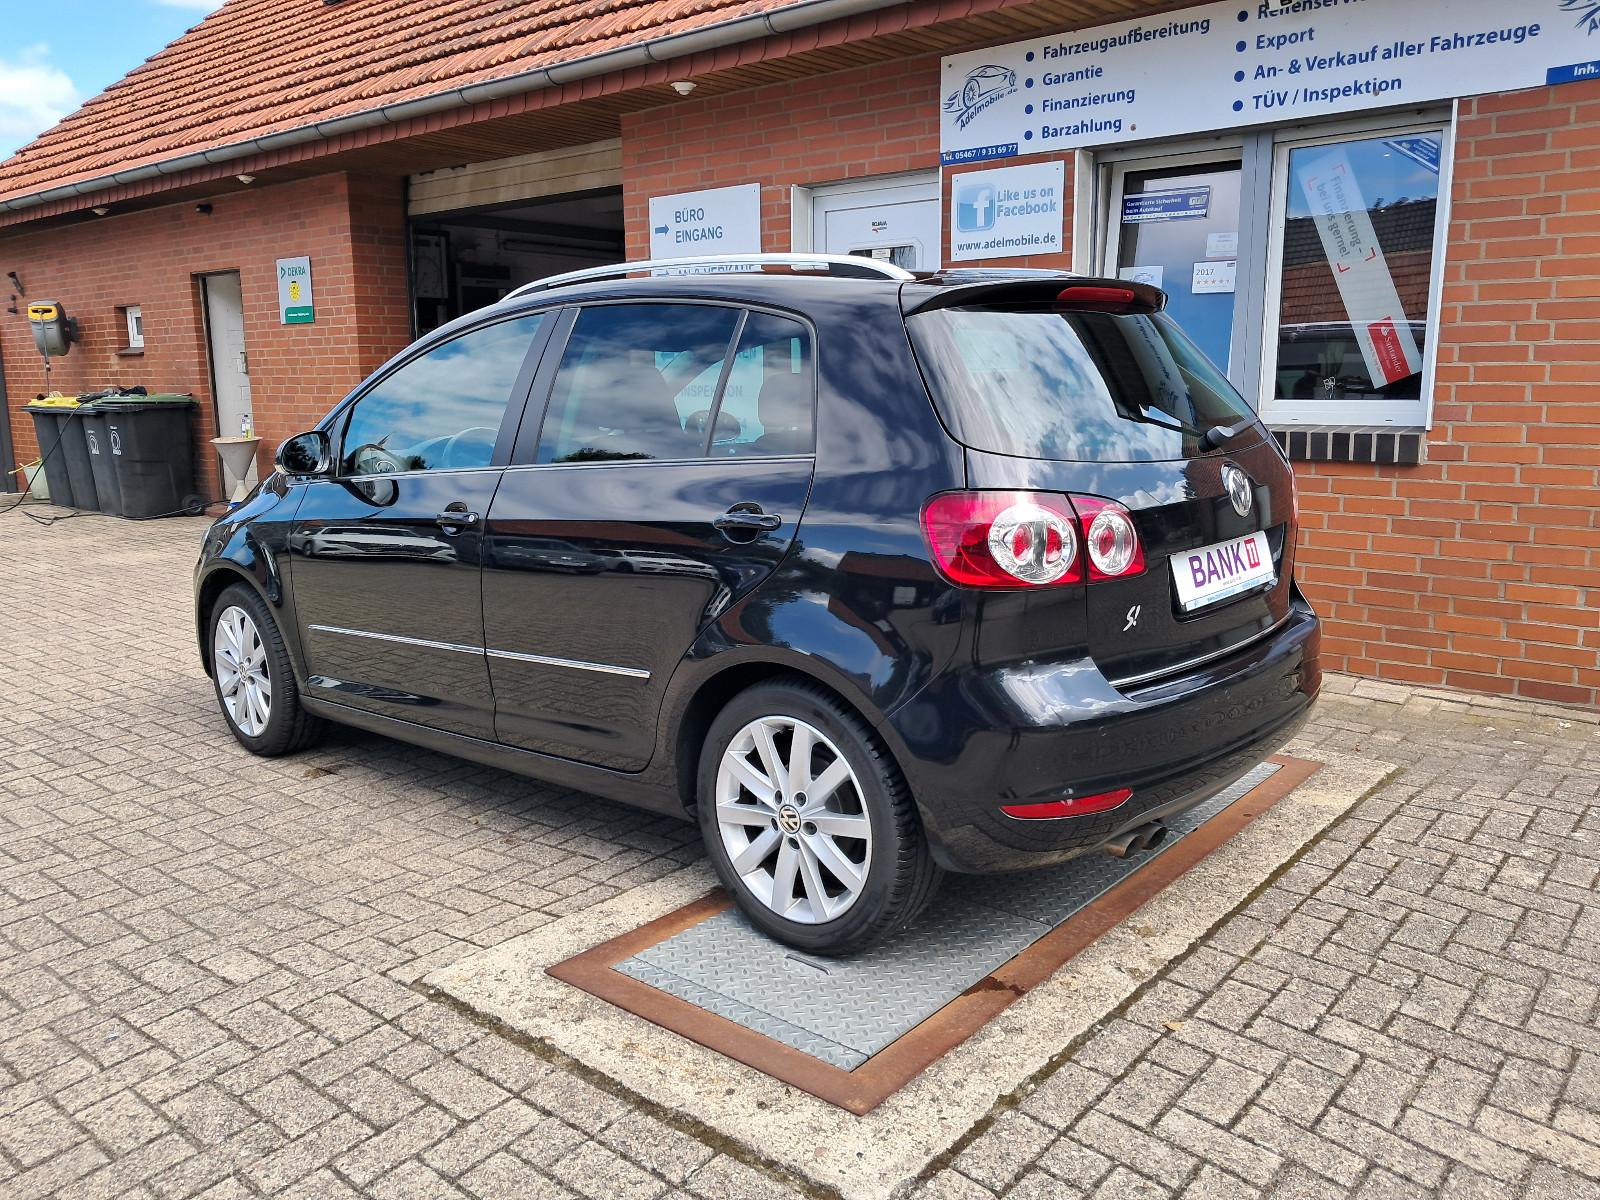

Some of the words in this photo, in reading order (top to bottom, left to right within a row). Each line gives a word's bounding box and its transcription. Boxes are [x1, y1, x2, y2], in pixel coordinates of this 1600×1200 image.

[1043, 18, 1211, 59] Fahrzeugaufbereitung
[1256, 27, 1315, 50] Export
[1254, 65, 1283, 80] An-
[1288, 59, 1301, 75] &
[1305, 44, 1379, 71] Verkauf
[1382, 41, 1425, 60] aller
[1430, 23, 1541, 53] Fahrzeuge
[1043, 65, 1103, 86] Garantie
[1574, 63, 1599, 76] Inh.
[1042, 87, 1136, 112] Finanzierung
[1253, 90, 1288, 110] TÜV
[1303, 78, 1402, 103] Inspektion
[960, 88, 1018, 131] Adelmobile.de
[1042, 117, 1122, 139] Barzahlung
[955, 150, 976, 159] 05467
[981, 148, 986, 156] 9
[988, 147, 996, 156] 33
[1008, 144, 1017, 152] 77
[997, 190, 1020, 202] Like
[1023, 189, 1036, 199] us
[1040, 187, 1054, 197] on
[674, 207, 705, 224] BÜRO
[996, 200, 1056, 217] Facebook
[675, 226, 723, 243] EINGANG
[957, 233, 1056, 251] www.adelmobile.de
[1327, 221, 1351, 258] gerne!
